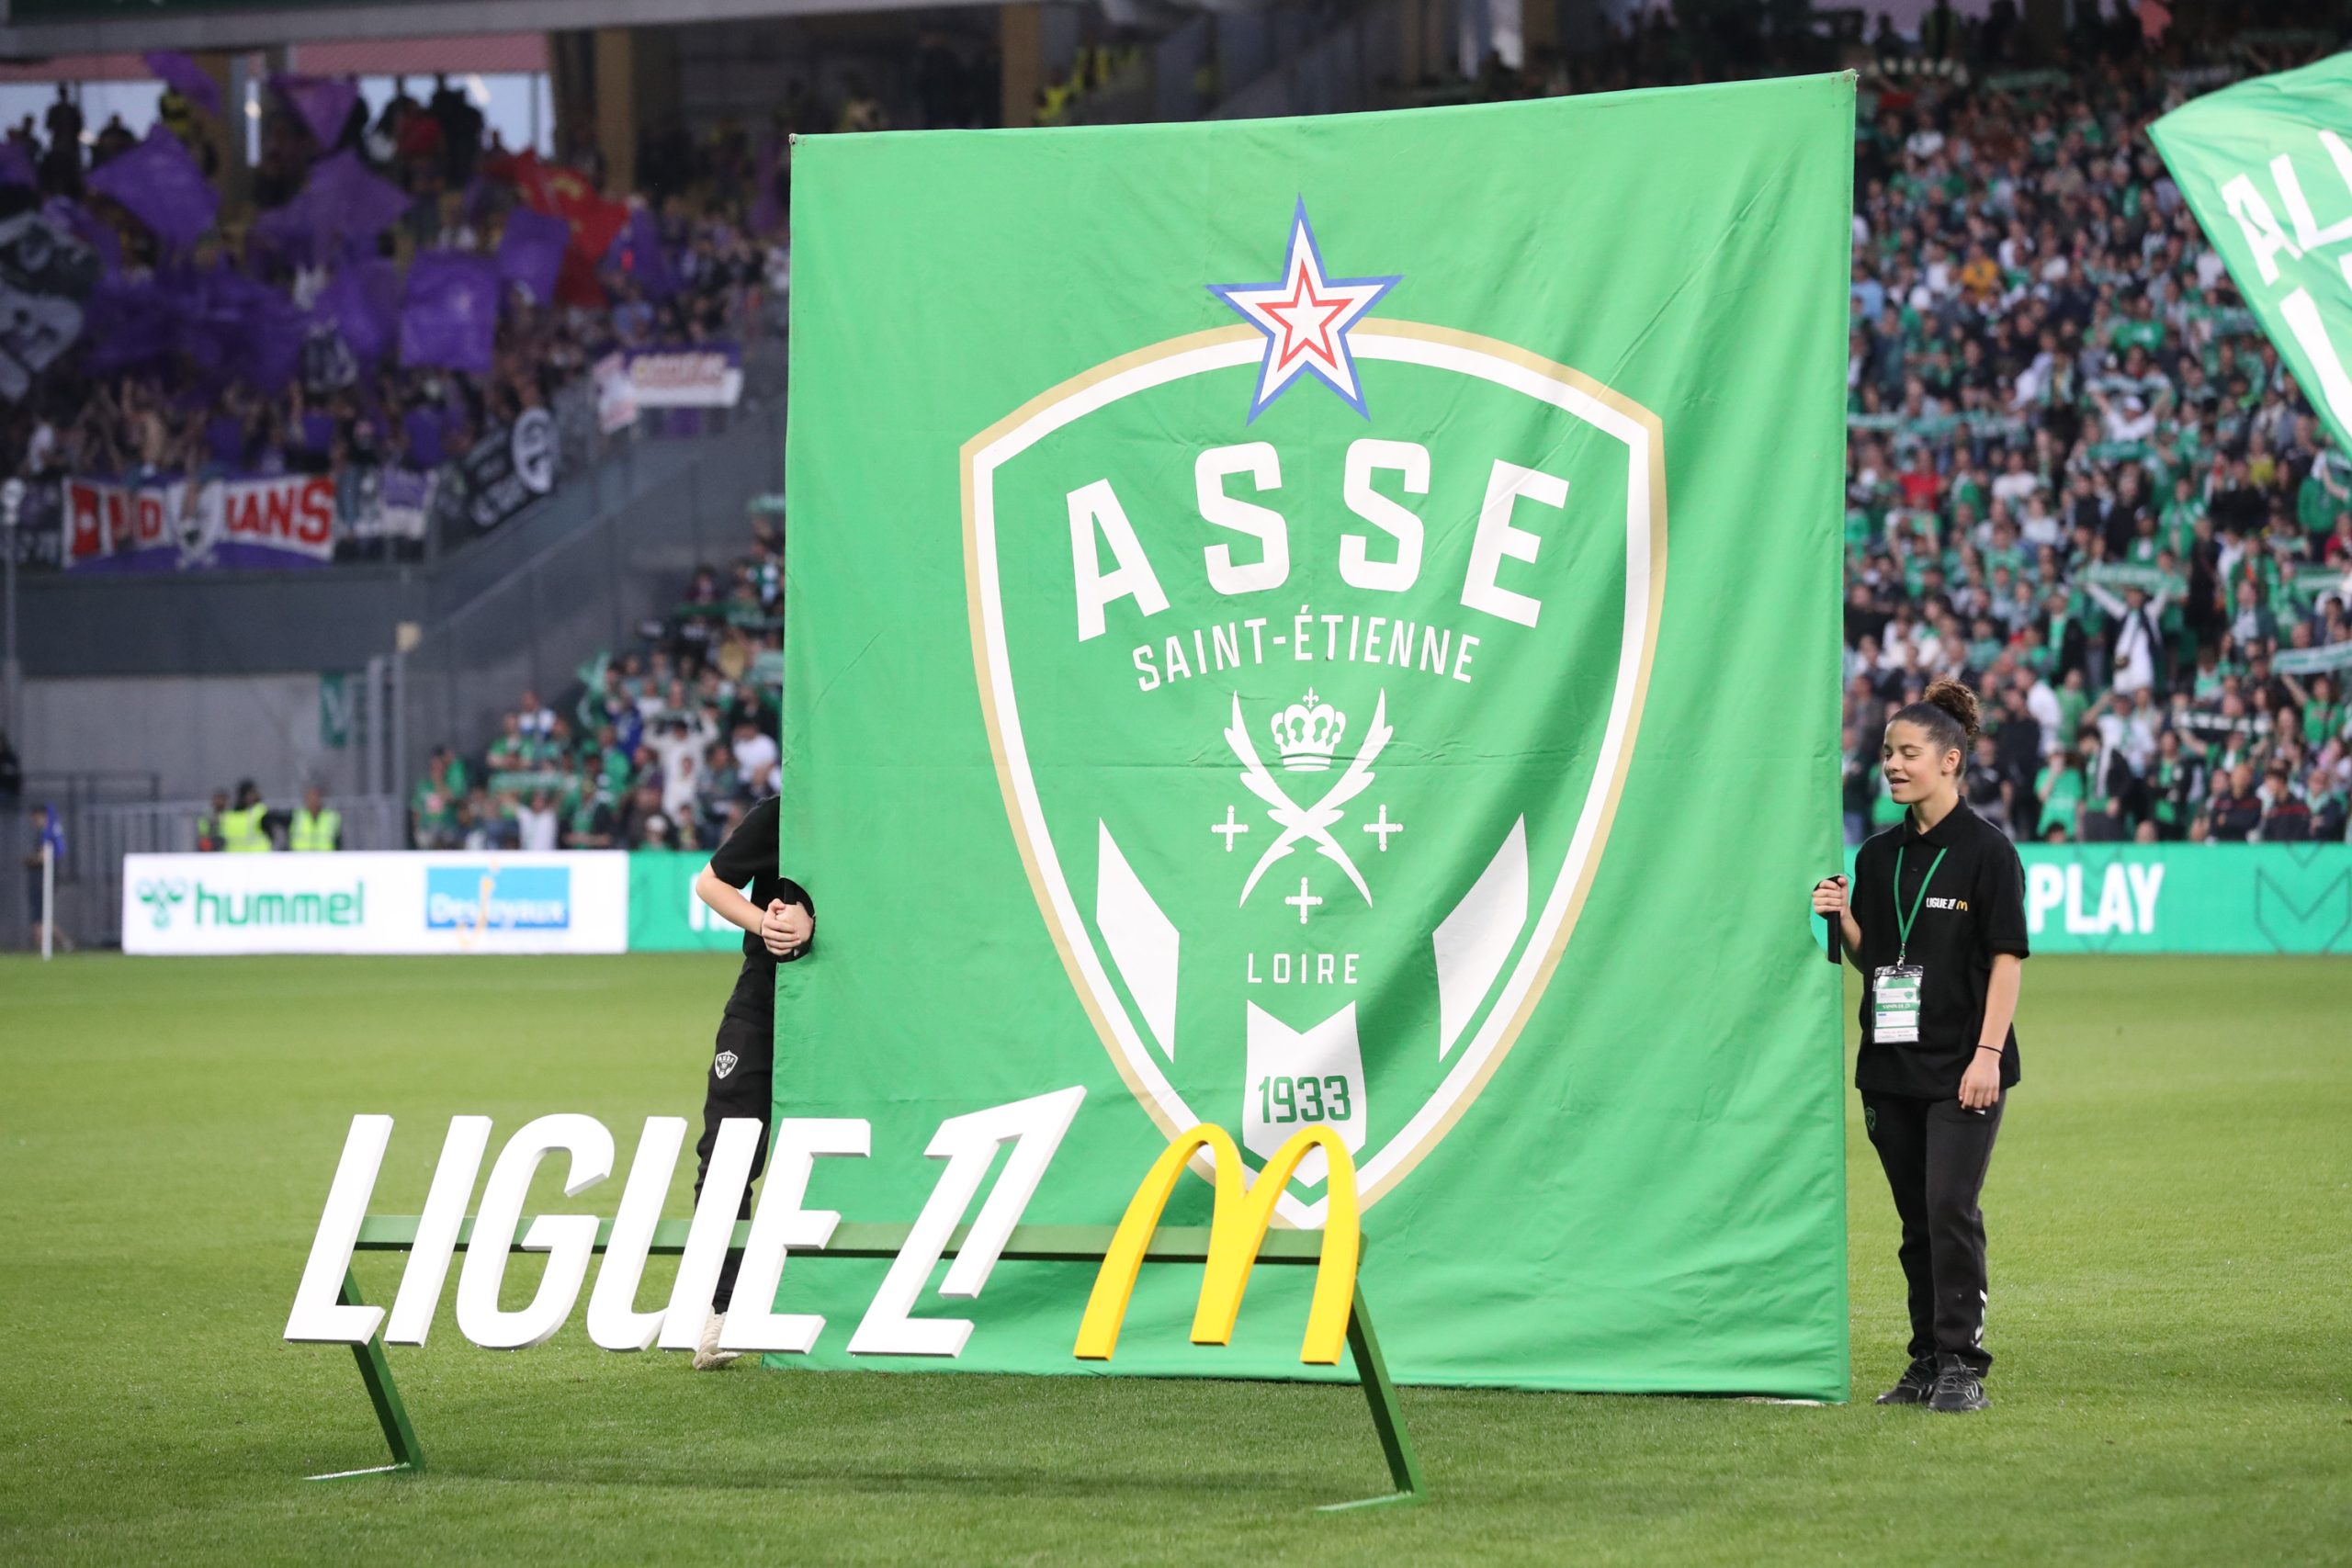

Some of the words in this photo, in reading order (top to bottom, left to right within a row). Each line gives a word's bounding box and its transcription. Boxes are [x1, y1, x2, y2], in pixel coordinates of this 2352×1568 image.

[1066, 438, 1569, 643] ASSE
[1132, 604, 1480, 692] SAINT-ÉTIENNE
[195, 881, 365, 926] hummel
[2029, 862, 2165, 934] PLAY
[1247, 953, 1360, 985] LOIRE
[1258, 1075, 1351, 1123] 1933
[283, 1113, 871, 1355] LIGUE
